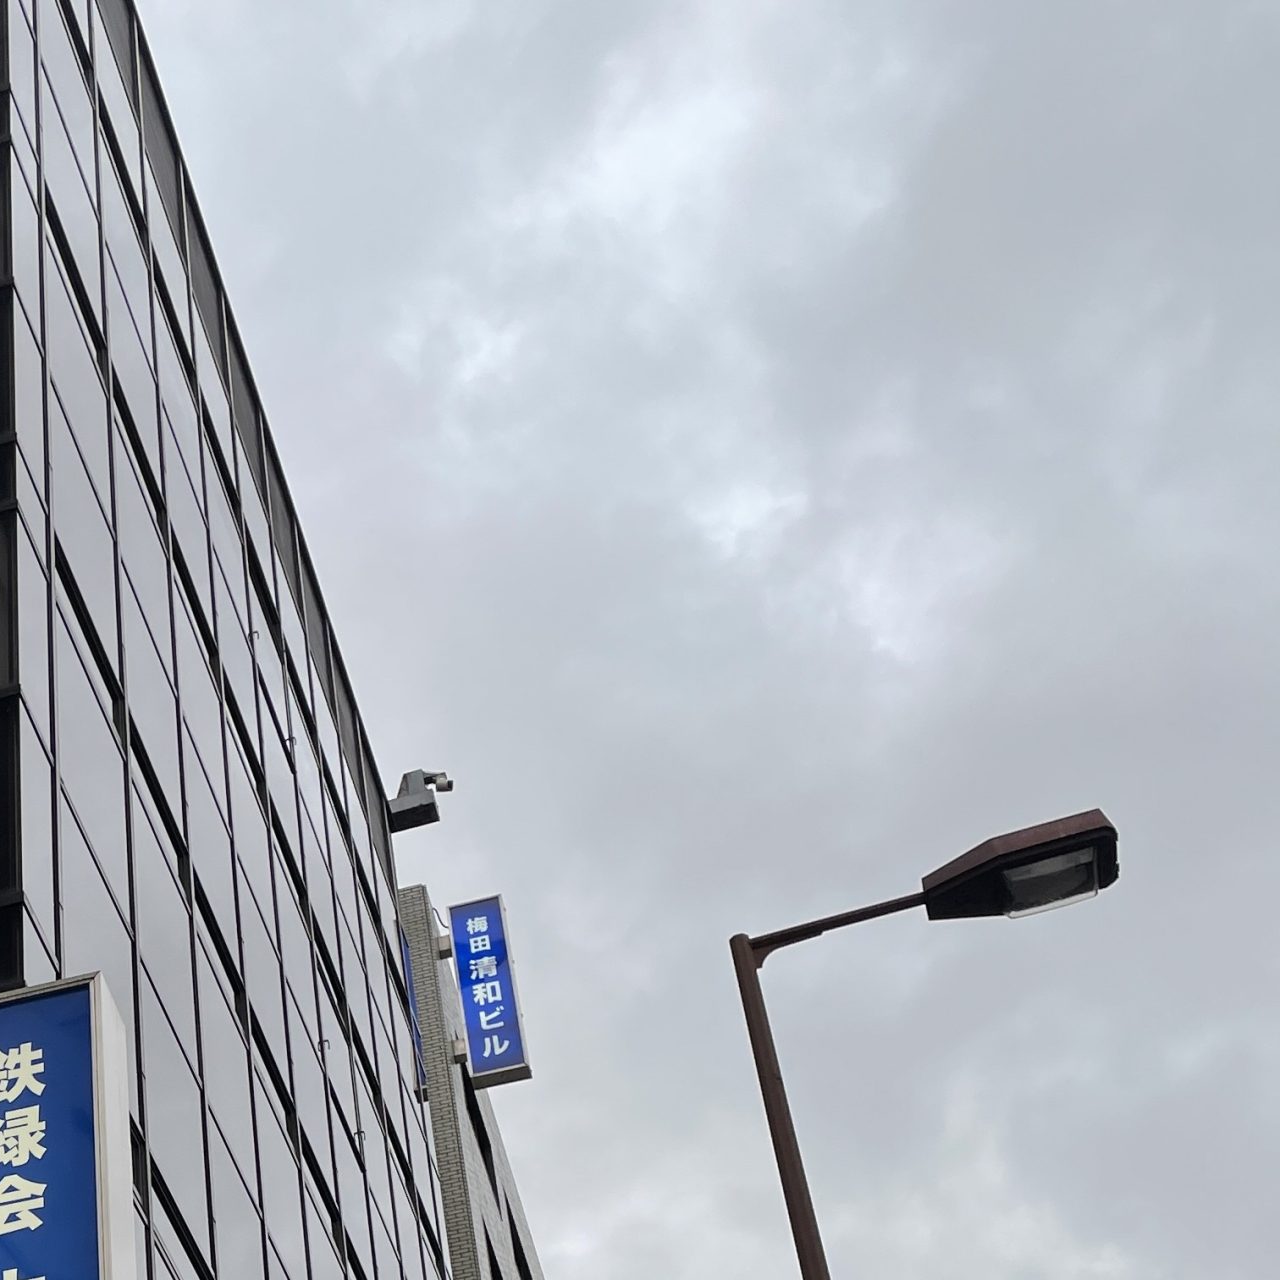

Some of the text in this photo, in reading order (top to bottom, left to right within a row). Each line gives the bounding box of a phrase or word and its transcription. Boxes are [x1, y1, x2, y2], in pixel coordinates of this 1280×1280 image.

[466, 916, 509, 1058] 梅田清和ビル
